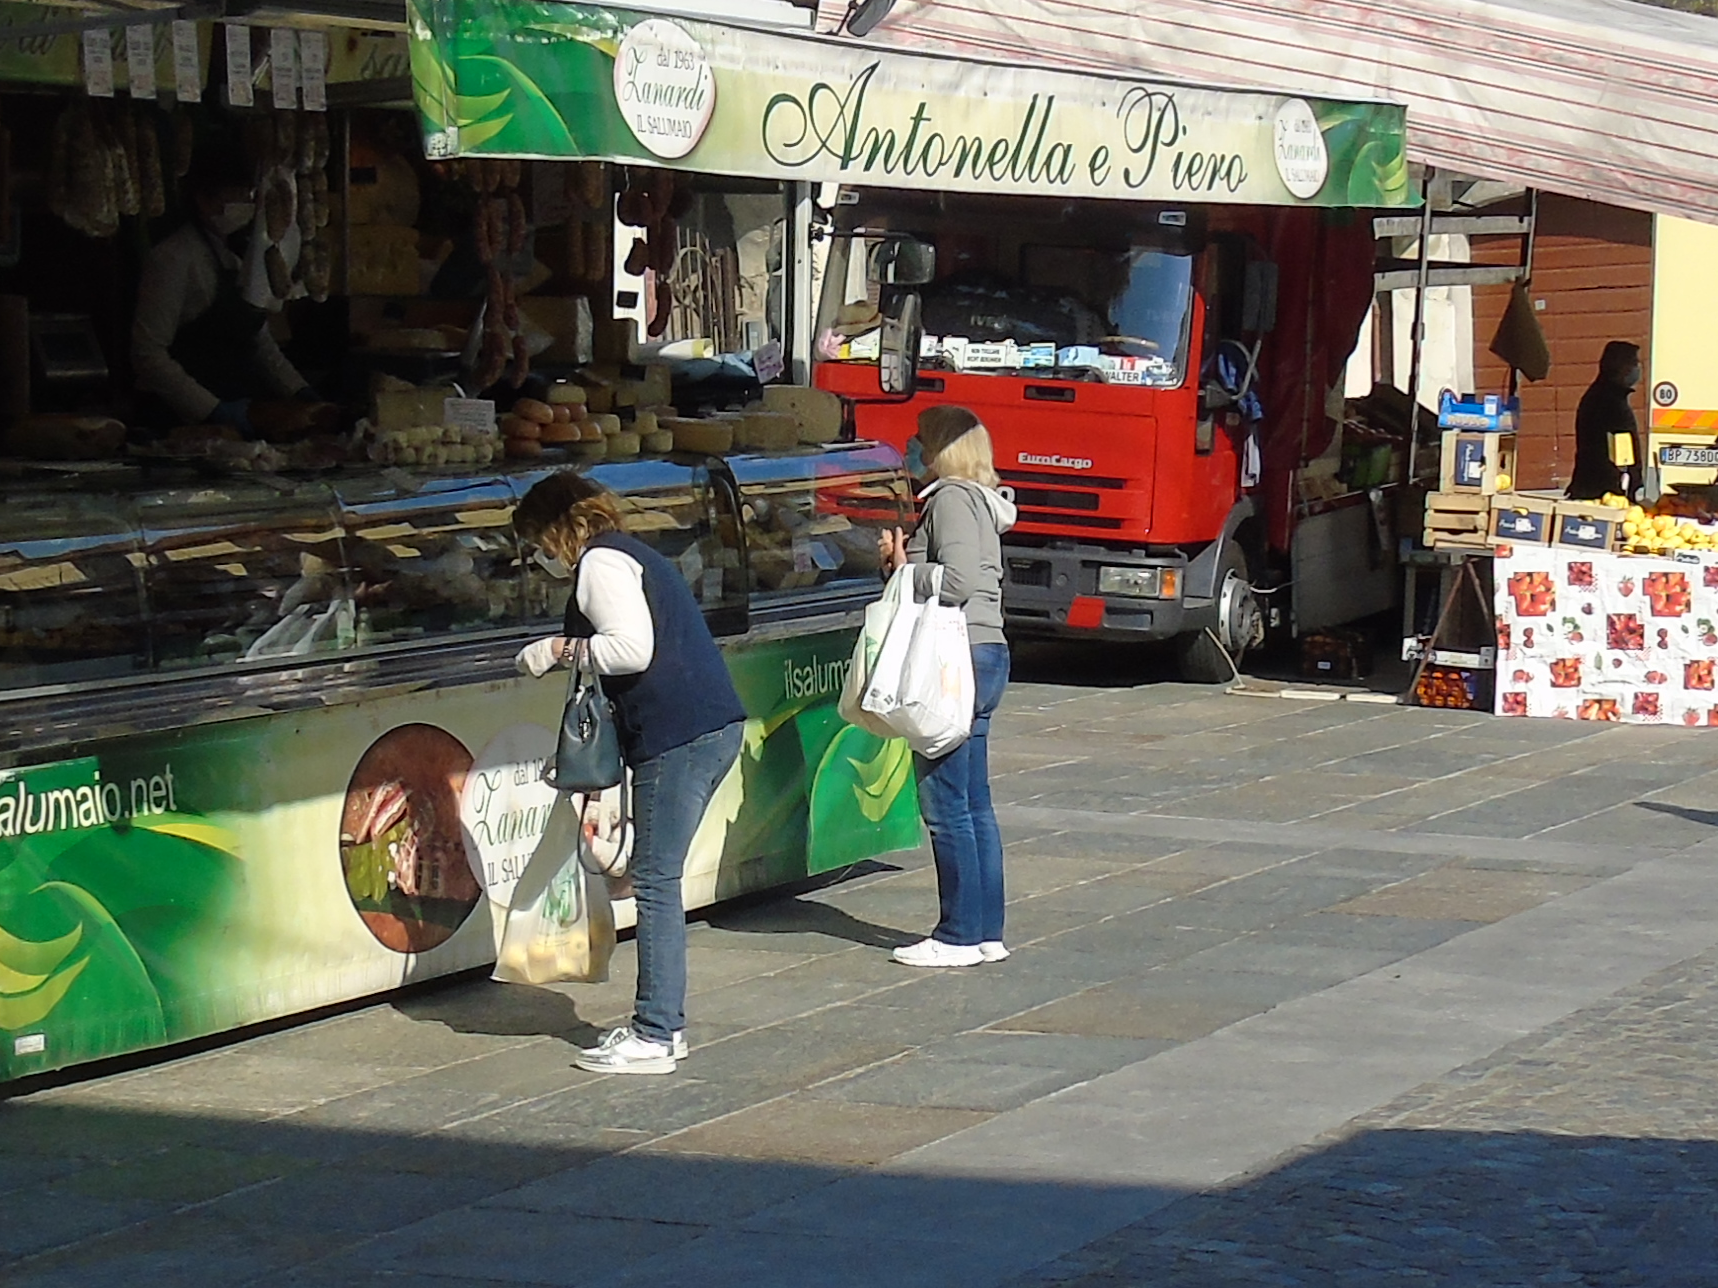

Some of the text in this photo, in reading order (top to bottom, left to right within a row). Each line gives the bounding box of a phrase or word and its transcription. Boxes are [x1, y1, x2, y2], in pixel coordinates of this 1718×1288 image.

[674, 49, 695, 71] 1963
[622, 47, 708, 111] Zanardi
[637, 114, 692, 139] IL SALUMAIO
[762, 60, 1249, 193] Antonella e Piero
[1659, 389, 1672, 399] 80
[1018, 452, 1092, 469] EuroCargo
[1668, 448, 1682, 461] BP
[514, 762, 529, 787] dal
[487, 862, 499, 887] IL
